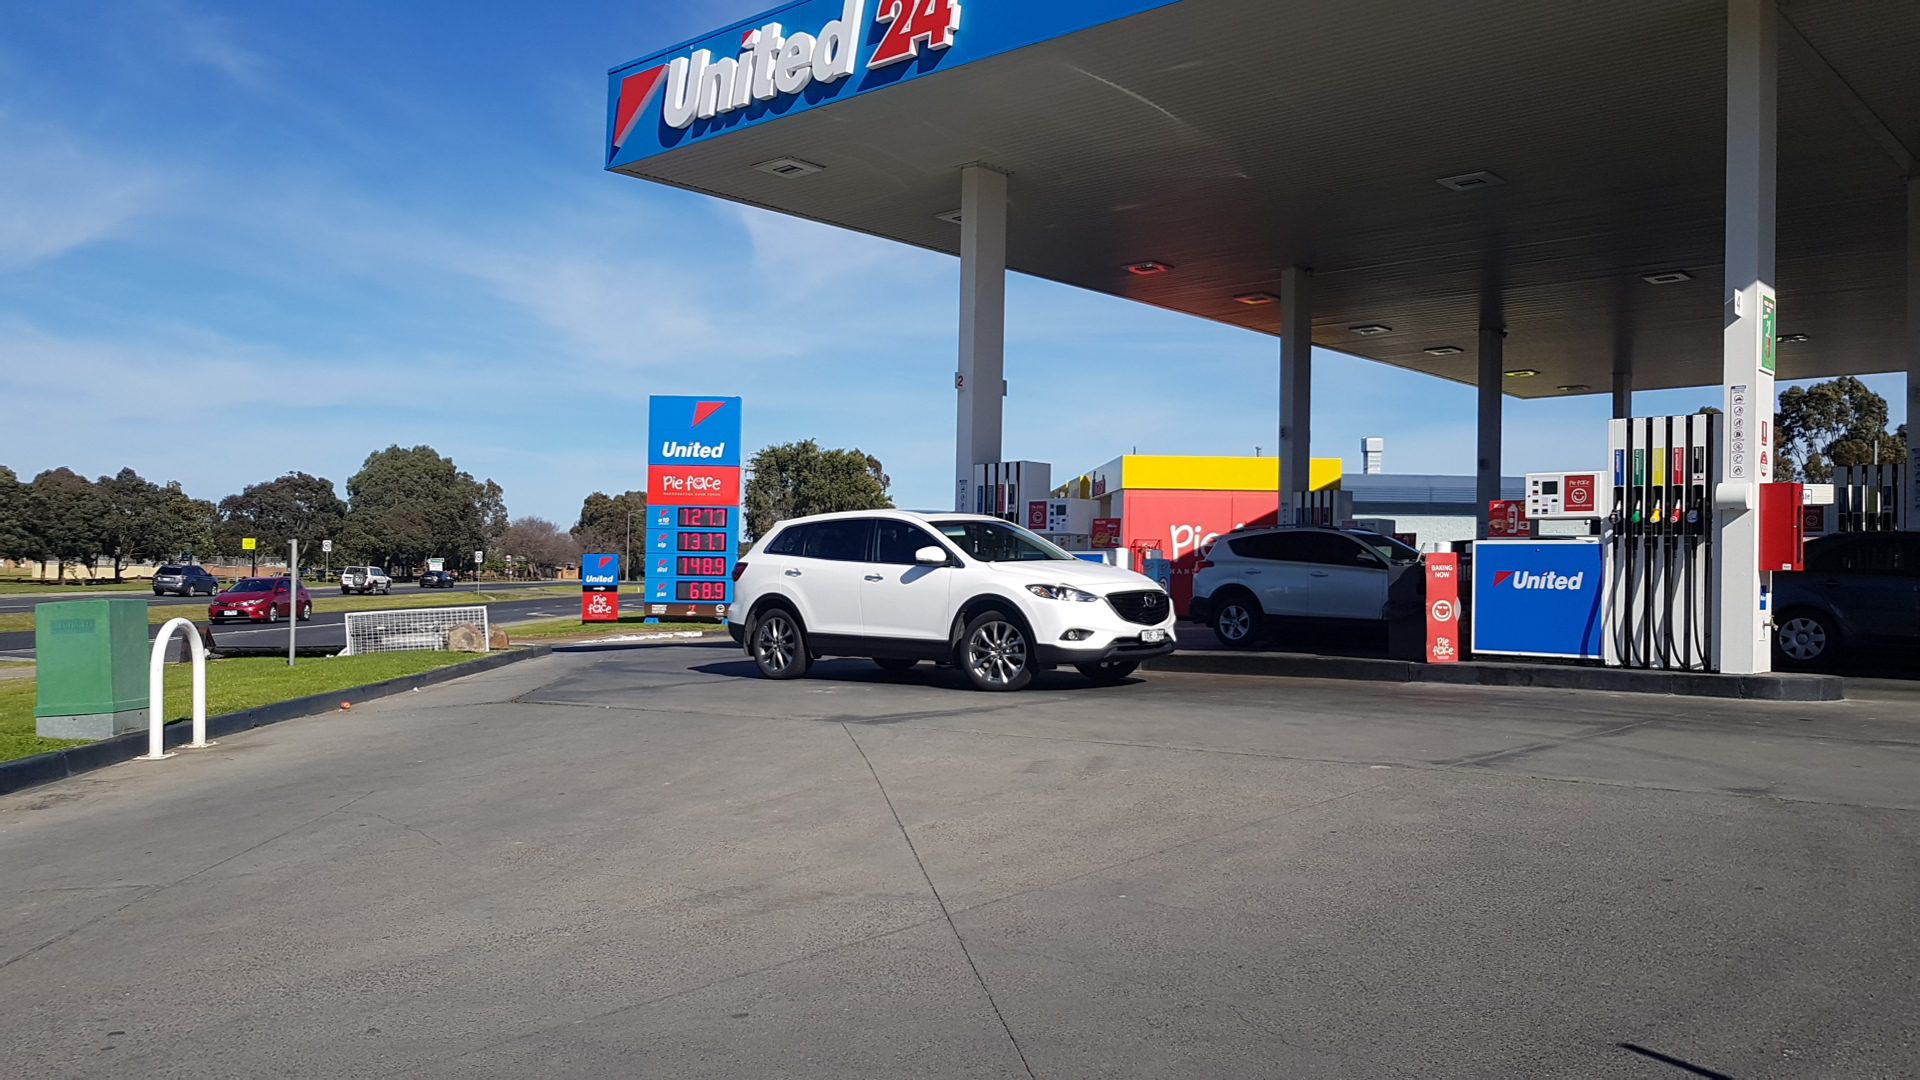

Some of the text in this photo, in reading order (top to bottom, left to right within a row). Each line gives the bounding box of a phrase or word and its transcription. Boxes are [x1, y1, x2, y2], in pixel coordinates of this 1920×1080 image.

[663, 0, 962, 129] United 24
[957, 375, 964, 387] 2
[662, 441, 725, 458] United
[663, 475, 722, 491] Pie face
[682, 557, 724, 575] 148.9
[585, 575, 614, 583] United
[1512, 571, 1584, 590] United
[689, 582, 724, 600] 68.9
[1436, 637, 1450, 648] Pie
[1432, 645, 1454, 657] face
